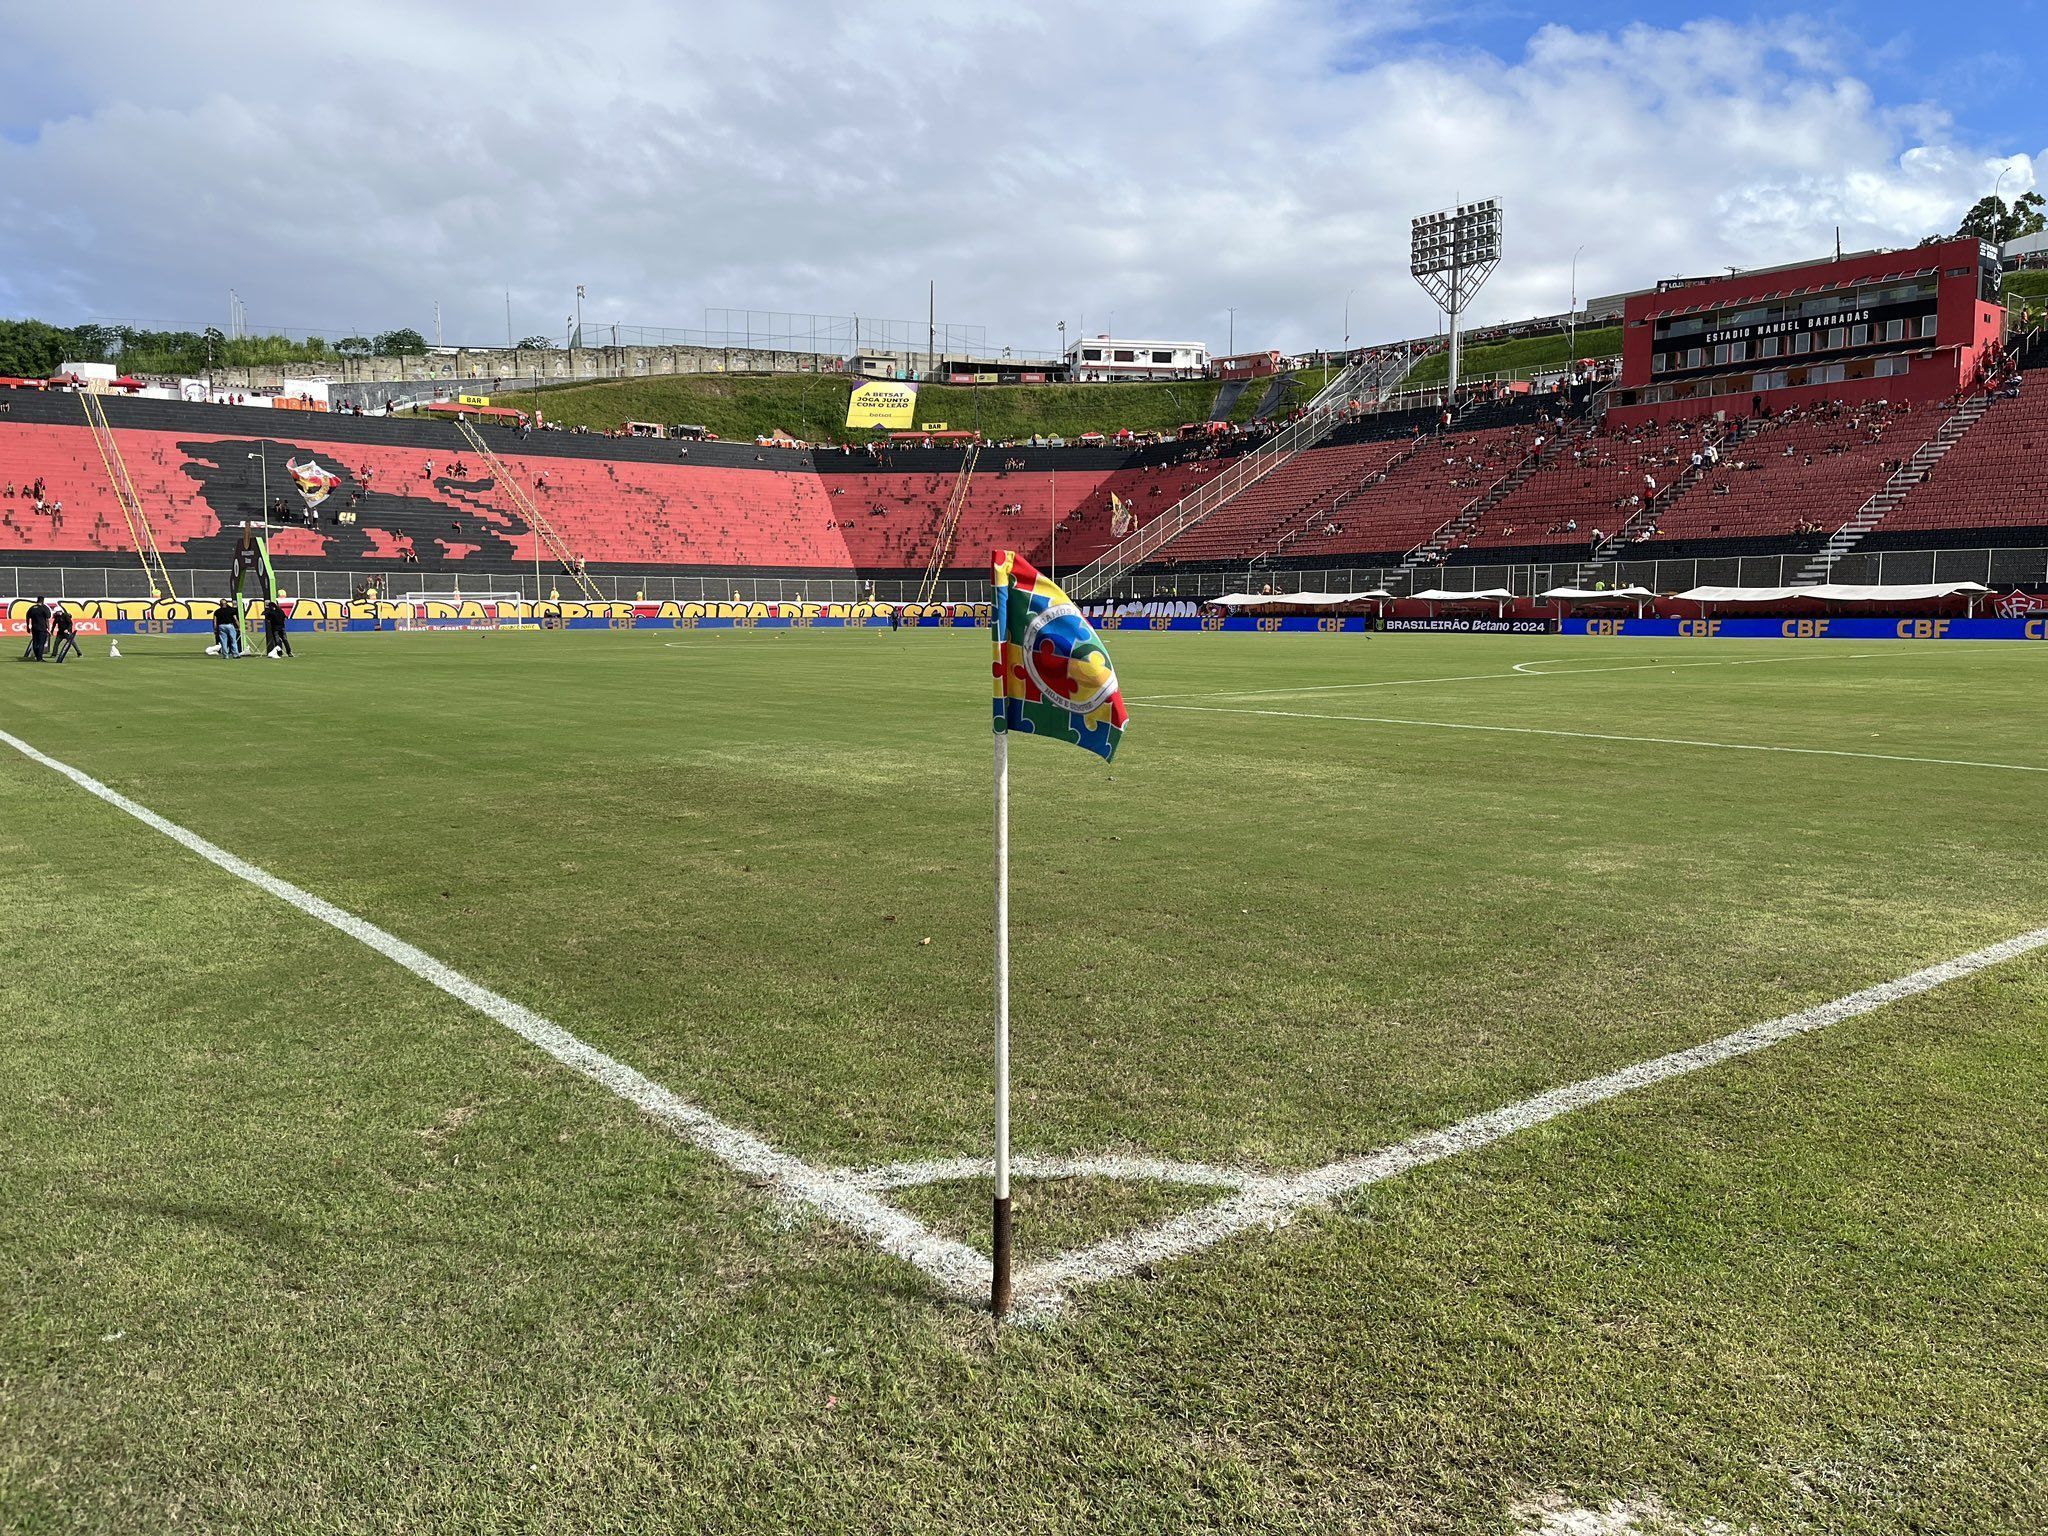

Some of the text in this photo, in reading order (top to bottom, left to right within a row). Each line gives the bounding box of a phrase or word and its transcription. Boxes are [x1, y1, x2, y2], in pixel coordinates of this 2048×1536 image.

[1757, 320, 1800, 335] MANOEL
[1808, 310, 1869, 328] BARRADAS
[466, 396, 482, 404] BAR
[57, 597, 282, 619] VITÓRA
[74, 621, 101, 631] GOL
[134, 619, 177, 634] CBF
[313, 619, 349, 632] CBF
[608, 618, 638, 630] CBF
[672, 618, 700, 630] CBF
[733, 617, 759, 629] CBF
[790, 617, 814, 628] CBF
[843, 617, 867, 628] CBF
[900, 617, 920, 628] CBF
[938, 617, 954, 628] CBF
[1101, 618, 1122, 630] CBF
[1149, 618, 1172, 630] CBF
[1201, 618, 1225, 631] CBF
[1256, 618, 1283, 631] CBF
[1317, 618, 1346, 632] CBF
[1386, 618, 1545, 633] BRASILEIRÃO Betano 2024
[1586, 619, 1625, 636] CBF
[1678, 619, 1722, 637] CBF
[1781, 619, 1830, 638] CBF
[1896, 619, 1950, 639] CBF
